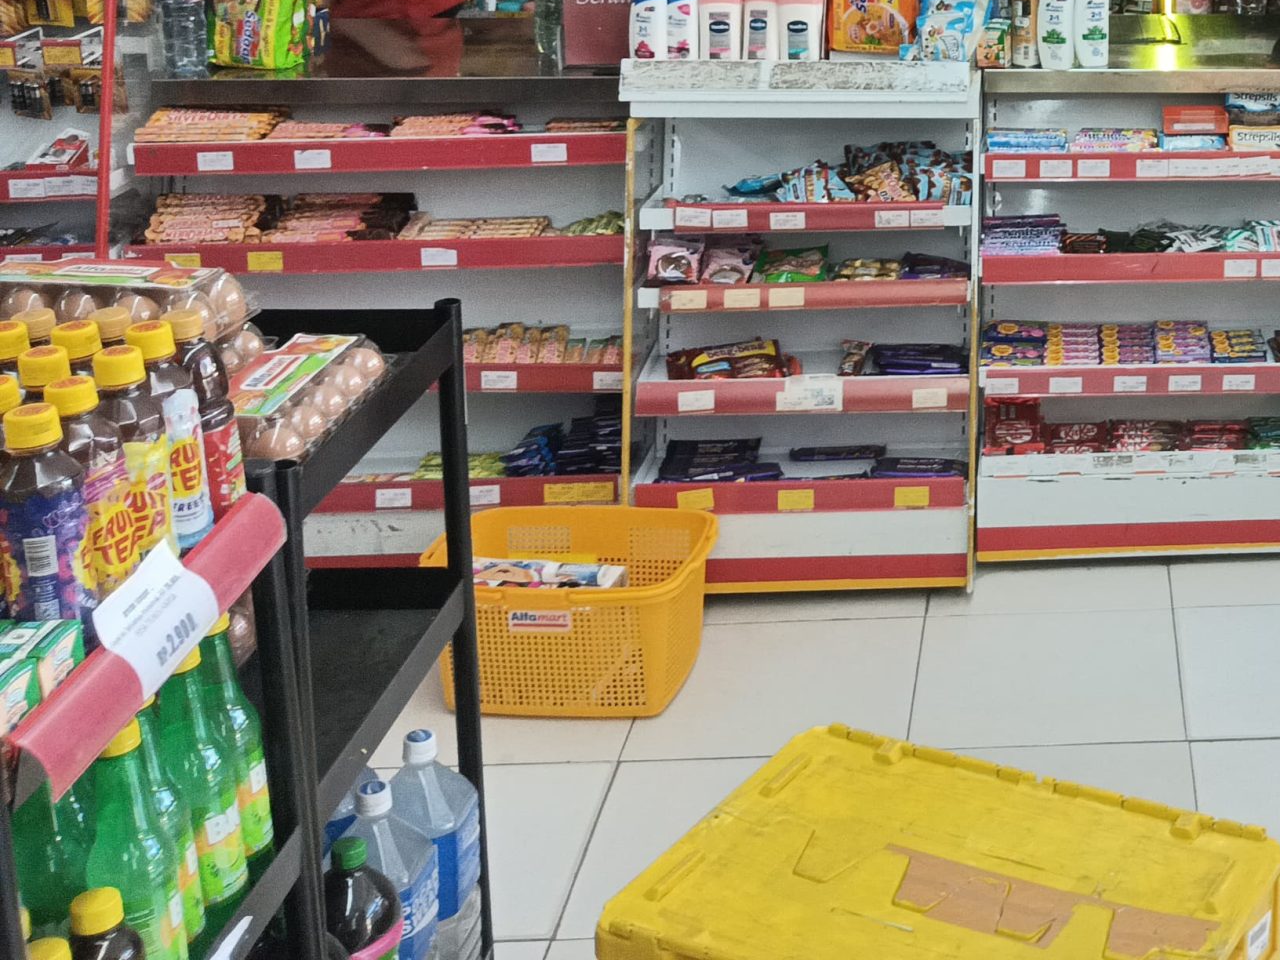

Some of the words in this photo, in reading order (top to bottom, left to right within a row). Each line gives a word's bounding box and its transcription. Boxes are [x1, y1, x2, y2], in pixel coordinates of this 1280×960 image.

[240, 10, 257, 66] Sedaap
[706, 341, 769, 358] beng-beng
[511, 612, 568, 622] Alfamart
